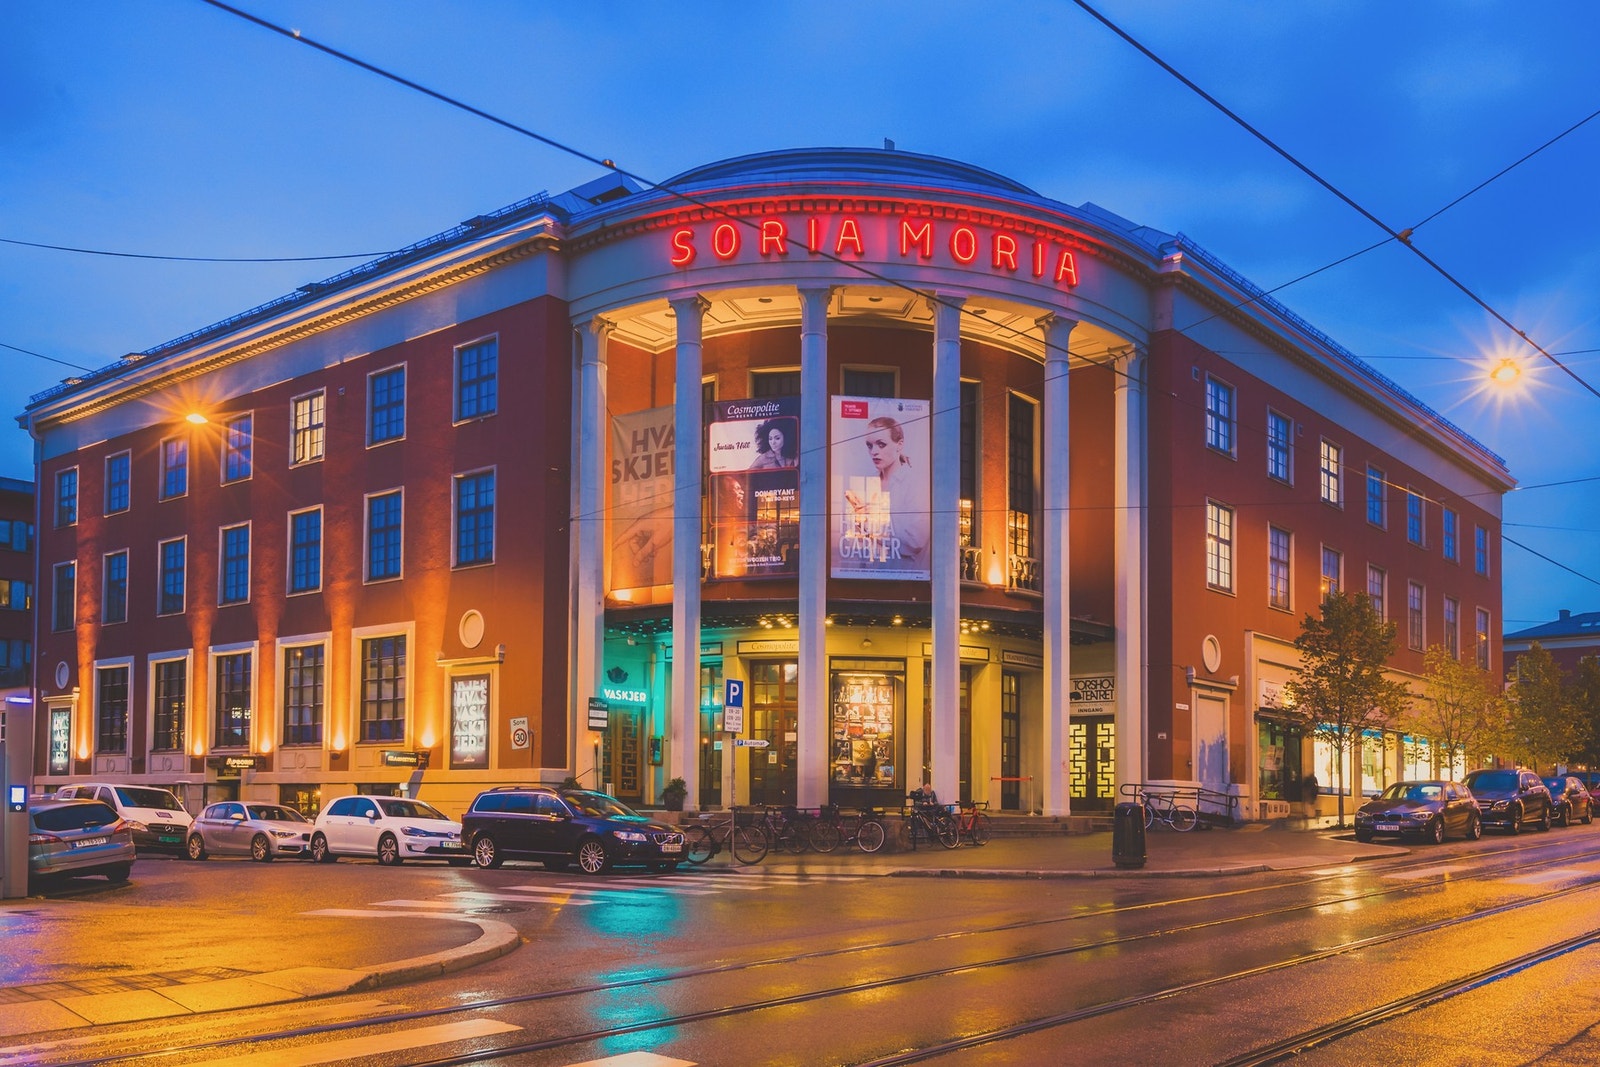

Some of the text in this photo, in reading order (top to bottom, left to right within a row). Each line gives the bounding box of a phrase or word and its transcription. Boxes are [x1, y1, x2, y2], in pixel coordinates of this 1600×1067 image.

[671, 216, 1079, 287] SORIA MORIA
[727, 401, 780, 416] Cosmopolite
[736, 441, 751, 450] Hill
[612, 450, 675, 484] SKJE
[840, 537, 901, 560] GABLER
[751, 642, 796, 651] Cosmopolite
[603, 688, 647, 703] VASKJER
[730, 683, 740, 704] P
[1081, 690, 1114, 700] TEATRET
[516, 732, 525, 743] 30
